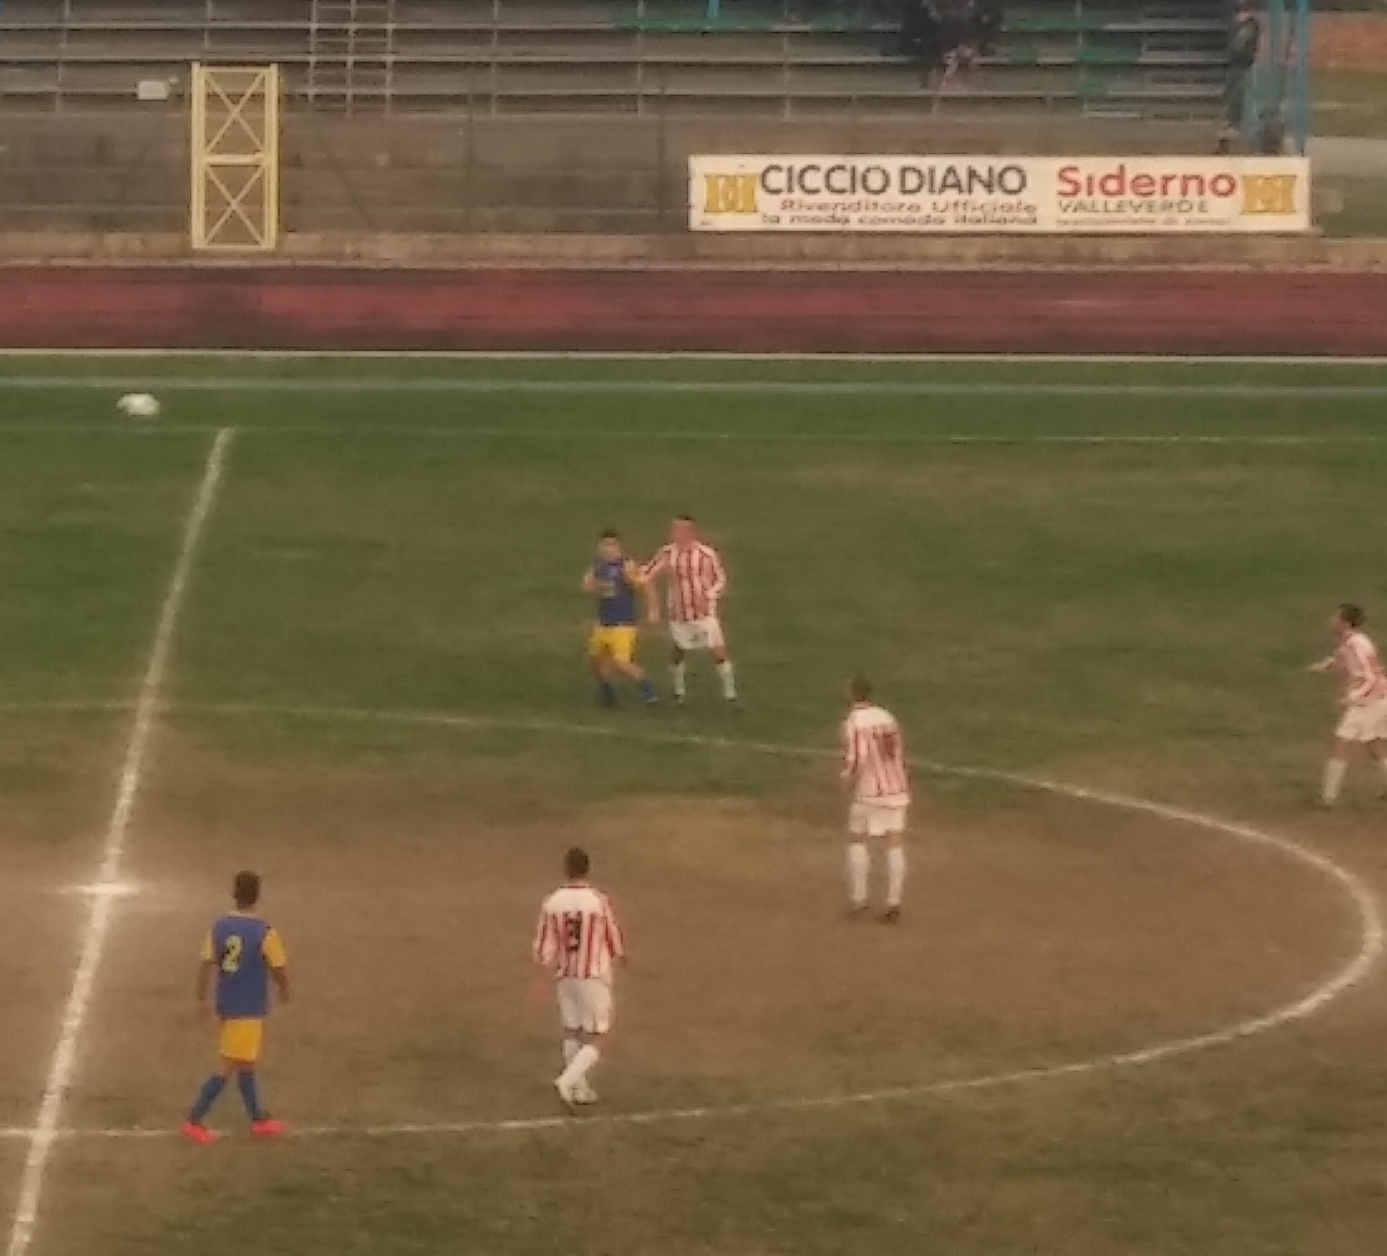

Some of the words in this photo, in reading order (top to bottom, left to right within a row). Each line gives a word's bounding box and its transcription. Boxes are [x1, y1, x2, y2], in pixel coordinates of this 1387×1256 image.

[761, 164, 891, 196] CICCIO
[899, 164, 1028, 196] DIANO
[1056, 164, 1236, 198] Siderno
[1058, 199, 1210, 213] VALLEVERDE
[221, 935, 243, 973] 2
